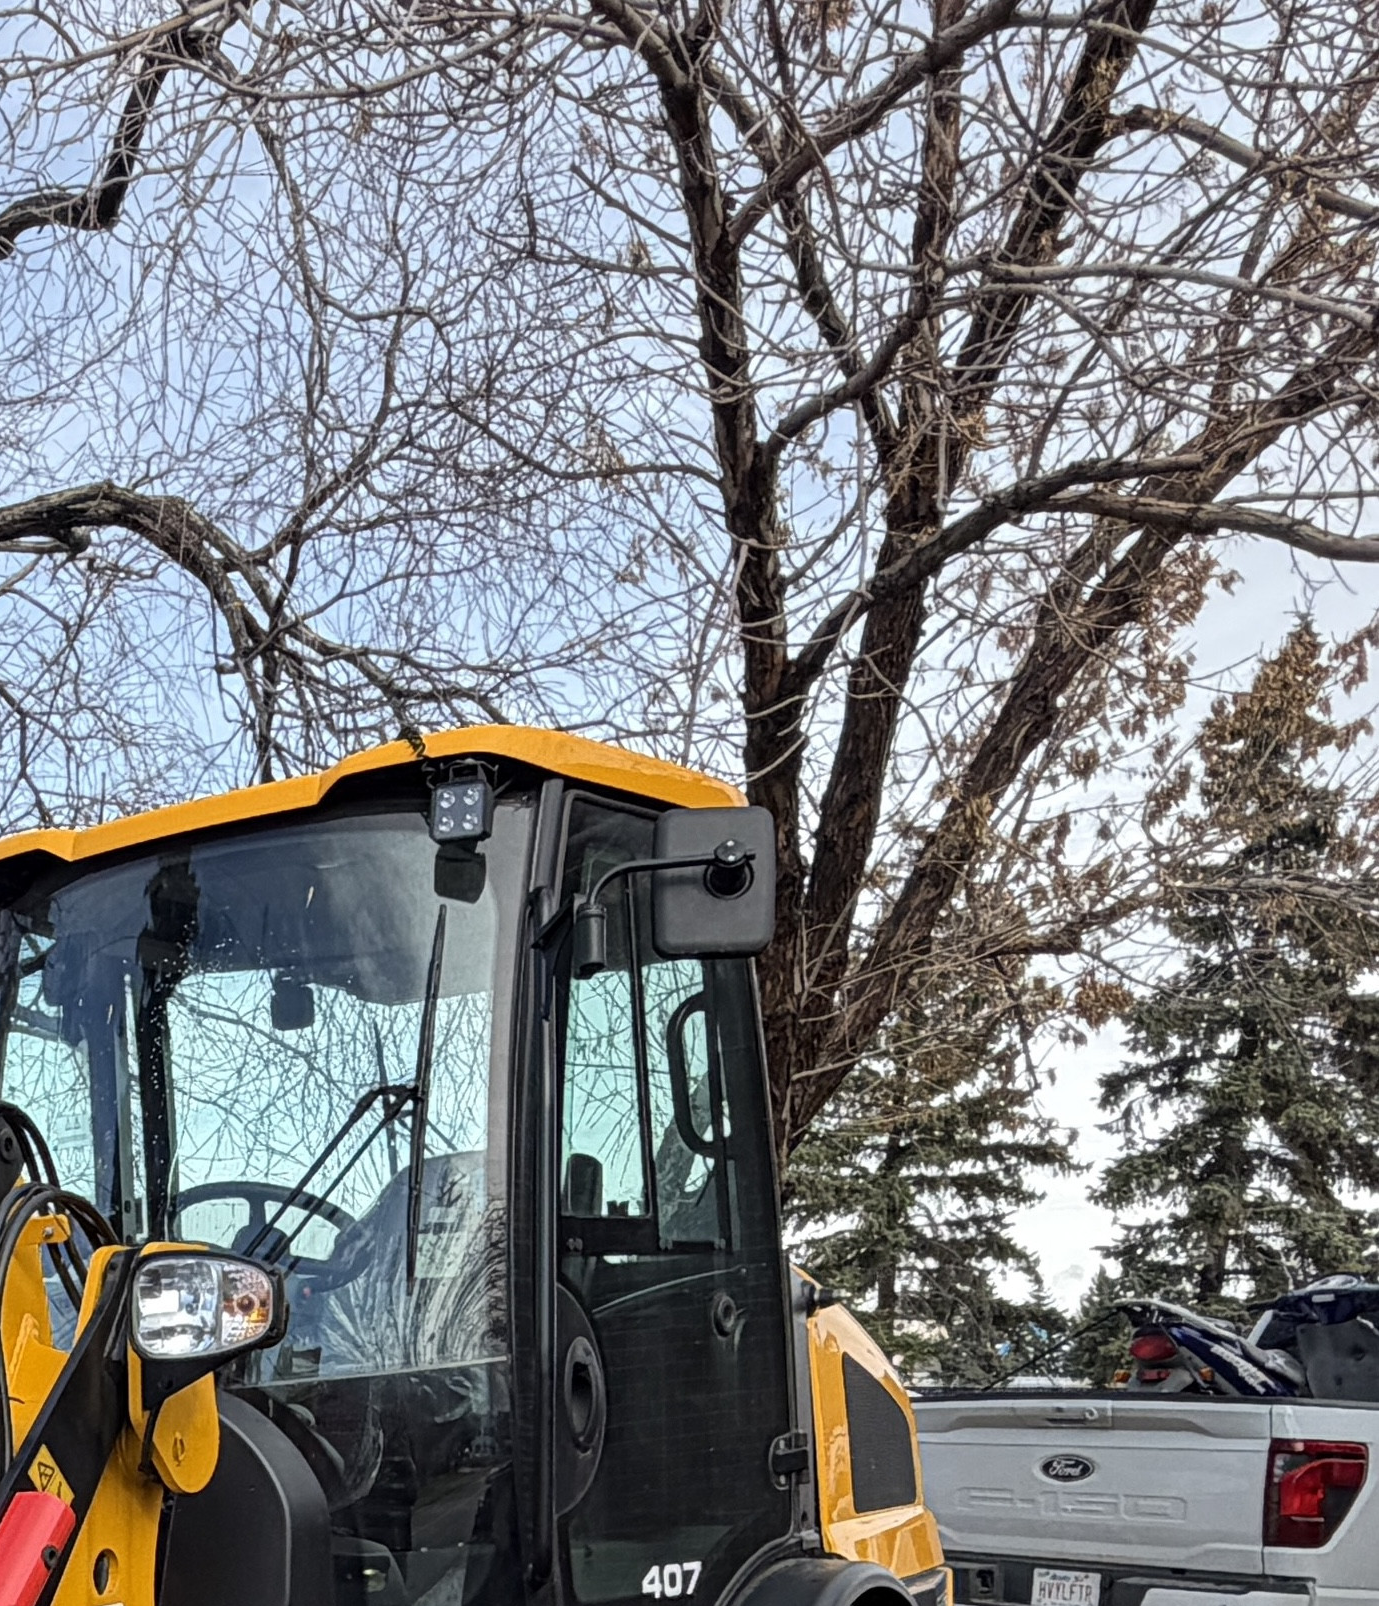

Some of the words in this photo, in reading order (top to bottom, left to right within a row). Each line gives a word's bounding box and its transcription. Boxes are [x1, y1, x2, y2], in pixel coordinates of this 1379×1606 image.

[1046, 1457, 1086, 1478] Ford
[955, 1486, 1188, 1523] F-150
[641, 1560, 703, 1599] 407
[1038, 1581, 1093, 1602] HVYLFTR
